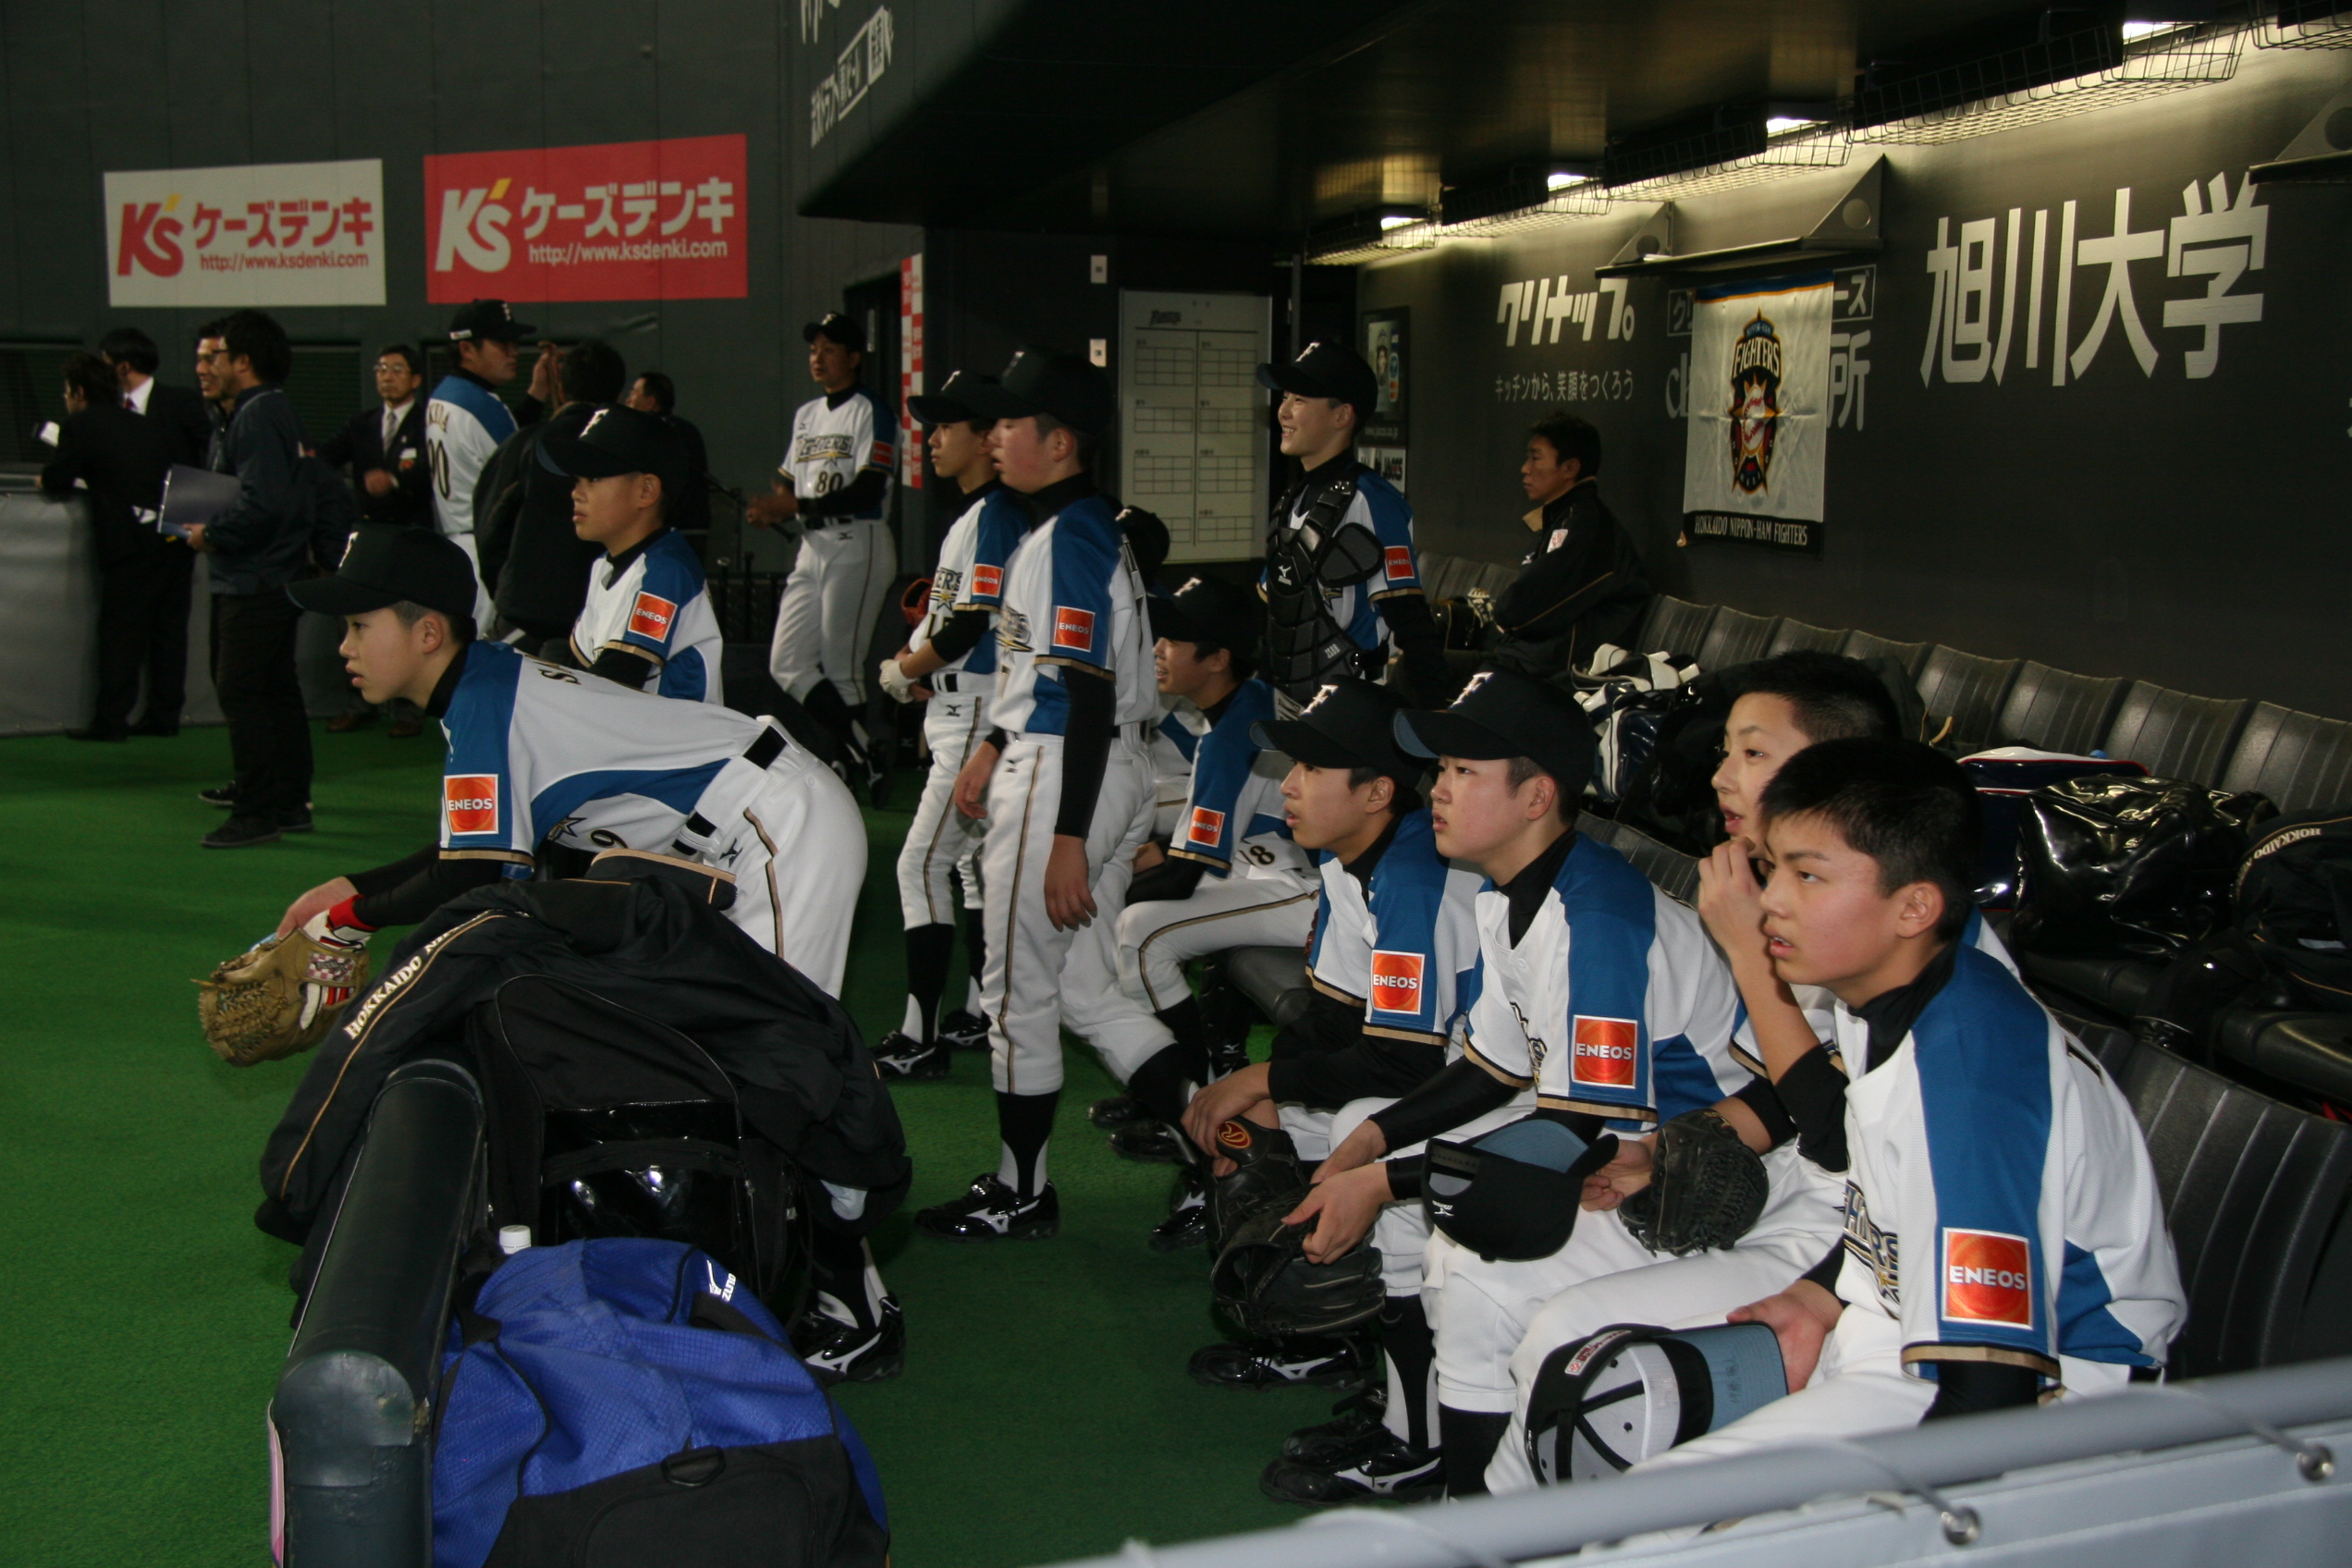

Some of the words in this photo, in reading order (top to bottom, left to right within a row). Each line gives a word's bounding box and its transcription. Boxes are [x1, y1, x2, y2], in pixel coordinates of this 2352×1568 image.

[520, 176, 735, 240] ケーズデンキ
[116, 193, 185, 277] K's
[192, 196, 374, 250] ケーズデンキ
[435, 178, 513, 274] K's
[200, 251, 370, 273] http://www.ksdenki.com
[528, 238, 729, 266] http://www.ksdenki.com
[1919, 170, 2270, 390] 旭川大学
[1732, 335, 1780, 379] FIGHTERS
[1494, 368, 1635, 404] キッチンから、笑顔をつくろう
[816, 470, 844, 494] 80
[1694, 514, 1728, 536] HOKKAIDO
[1729, 516, 1772, 542] NIPPON-HAM
[1774, 521, 1808, 546] FIGHTERS
[1388, 557, 1411, 567] ENEOS
[974, 575, 999, 585] ENEOS
[635, 607, 668, 626] ENEOS
[1059, 620, 1090, 636] ENEOS
[447, 795, 494, 812] ENEOS
[1192, 819, 1219, 834] ENEOS
[2252, 827, 2322, 860] HOKKAIDO
[1372, 974, 1418, 990] ENEOS
[343, 954, 423, 1040] HOKKAIDO
[1574, 1041, 1634, 1061] ENEOS
[1948, 1265, 2027, 1292] ENEOS
